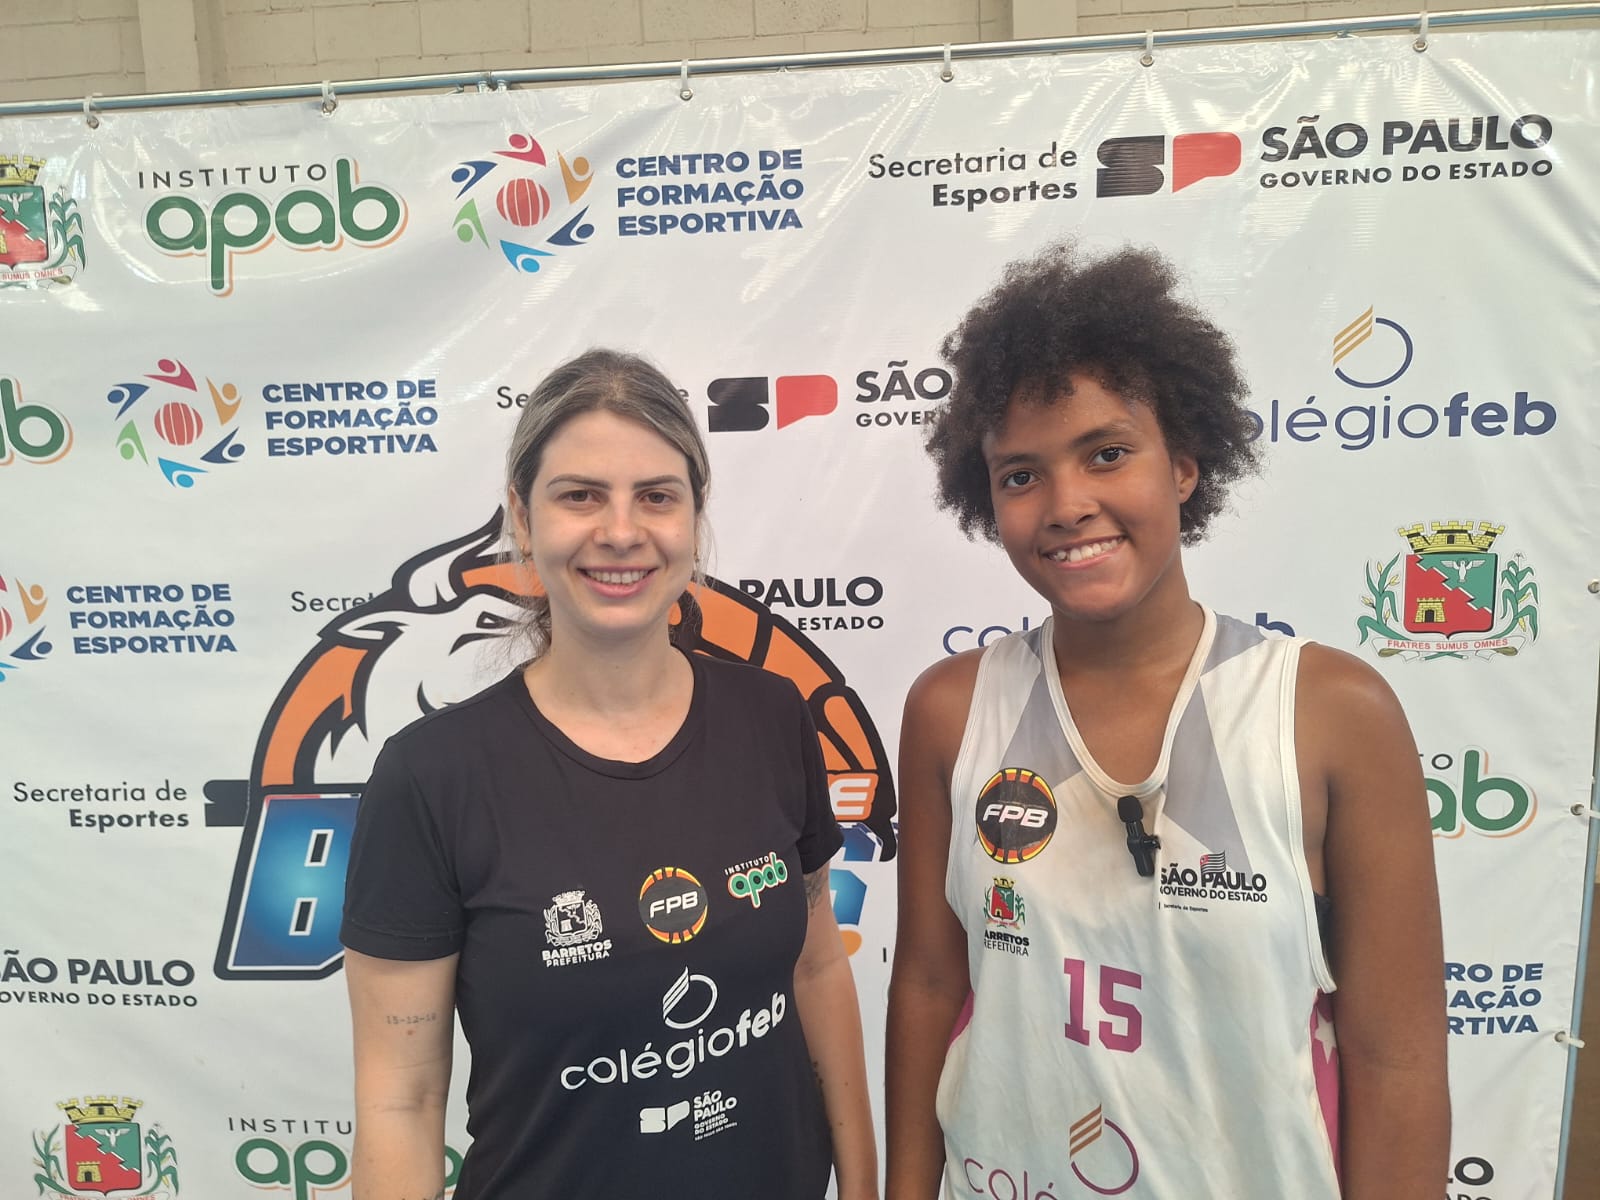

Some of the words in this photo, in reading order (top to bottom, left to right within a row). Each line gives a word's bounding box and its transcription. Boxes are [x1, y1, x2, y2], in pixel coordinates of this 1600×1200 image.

[1259, 115, 1369, 162] SÃO
[1382, 114, 1553, 156] PAULO
[615, 151, 749, 178] CENTRO
[758, 149, 803, 171] DE
[868, 147, 1026, 179] Secretaria
[1038, 141, 1078, 168] de
[138, 163, 327, 189] INSTITUTO
[1259, 167, 1392, 189] GOVERNO
[1402, 164, 1441, 182] DO
[1449, 160, 1553, 180] ESTADO
[616, 174, 804, 208] FORMAÇÃO
[932, 180, 1078, 212] Esportes
[146, 158, 401, 291] apab
[618, 208, 803, 236] ESPORTIVA
[262, 381, 389, 403] CENTRO
[396, 379, 437, 400] DE
[856, 360, 953, 403] SÃO
[265, 402, 438, 430] FORMAÇÃO
[856, 411, 937, 427] GOVER
[1238, 392, 1557, 451] olégiofeb
[267, 434, 438, 456] ESPORTIVA
[66, 585, 184, 604] CENTRO
[192, 583, 232, 602] DE
[291, 591, 373, 612] Secre
[739, 576, 884, 608] PAULO
[69, 605, 235, 631] FORMAÇÃO
[798, 616, 884, 631] ESTADO
[73, 634, 238, 655] ESPORTIVA
[1387, 640, 1431, 650] FRATRES
[1436, 642, 1469, 650] SUMUS
[1474, 638, 1508, 649] OMNES
[13, 780, 147, 803] Secretaria
[155, 779, 187, 801] de
[1425, 749, 1529, 832] ab
[69, 809, 189, 833] Esportes
[982, 803, 1049, 829] FPB
[724, 855, 770, 876] INSTITUTO
[729, 852, 787, 908] apab
[1201, 871, 1267, 892] PAULO
[650, 891, 699, 918] FPB
[1209, 889, 1226, 900] DO
[1228, 891, 1268, 903] ESTADO
[542, 939, 612, 961] BARRETOS
[985, 929, 1030, 947] ARRETOS
[0, 949, 58, 984] ÃO
[67, 958, 195, 987] PAULO
[546, 950, 610, 968] PREFEITURA
[1502, 963, 1544, 983] DE
[0, 991, 80, 1005] OVERNO
[87, 993, 116, 1005] DO
[123, 994, 197, 1007] ESTADO
[1064, 957, 1143, 1053] 15
[1446, 985, 1542, 1012] AÇÃO
[1447, 1014, 1539, 1035] RTIVA
[560, 992, 786, 1090] colégiofeb
[693, 1090, 722, 1109] SÃO
[694, 1096, 738, 1122] PAULO
[229, 1117, 352, 1135] INSTITU
